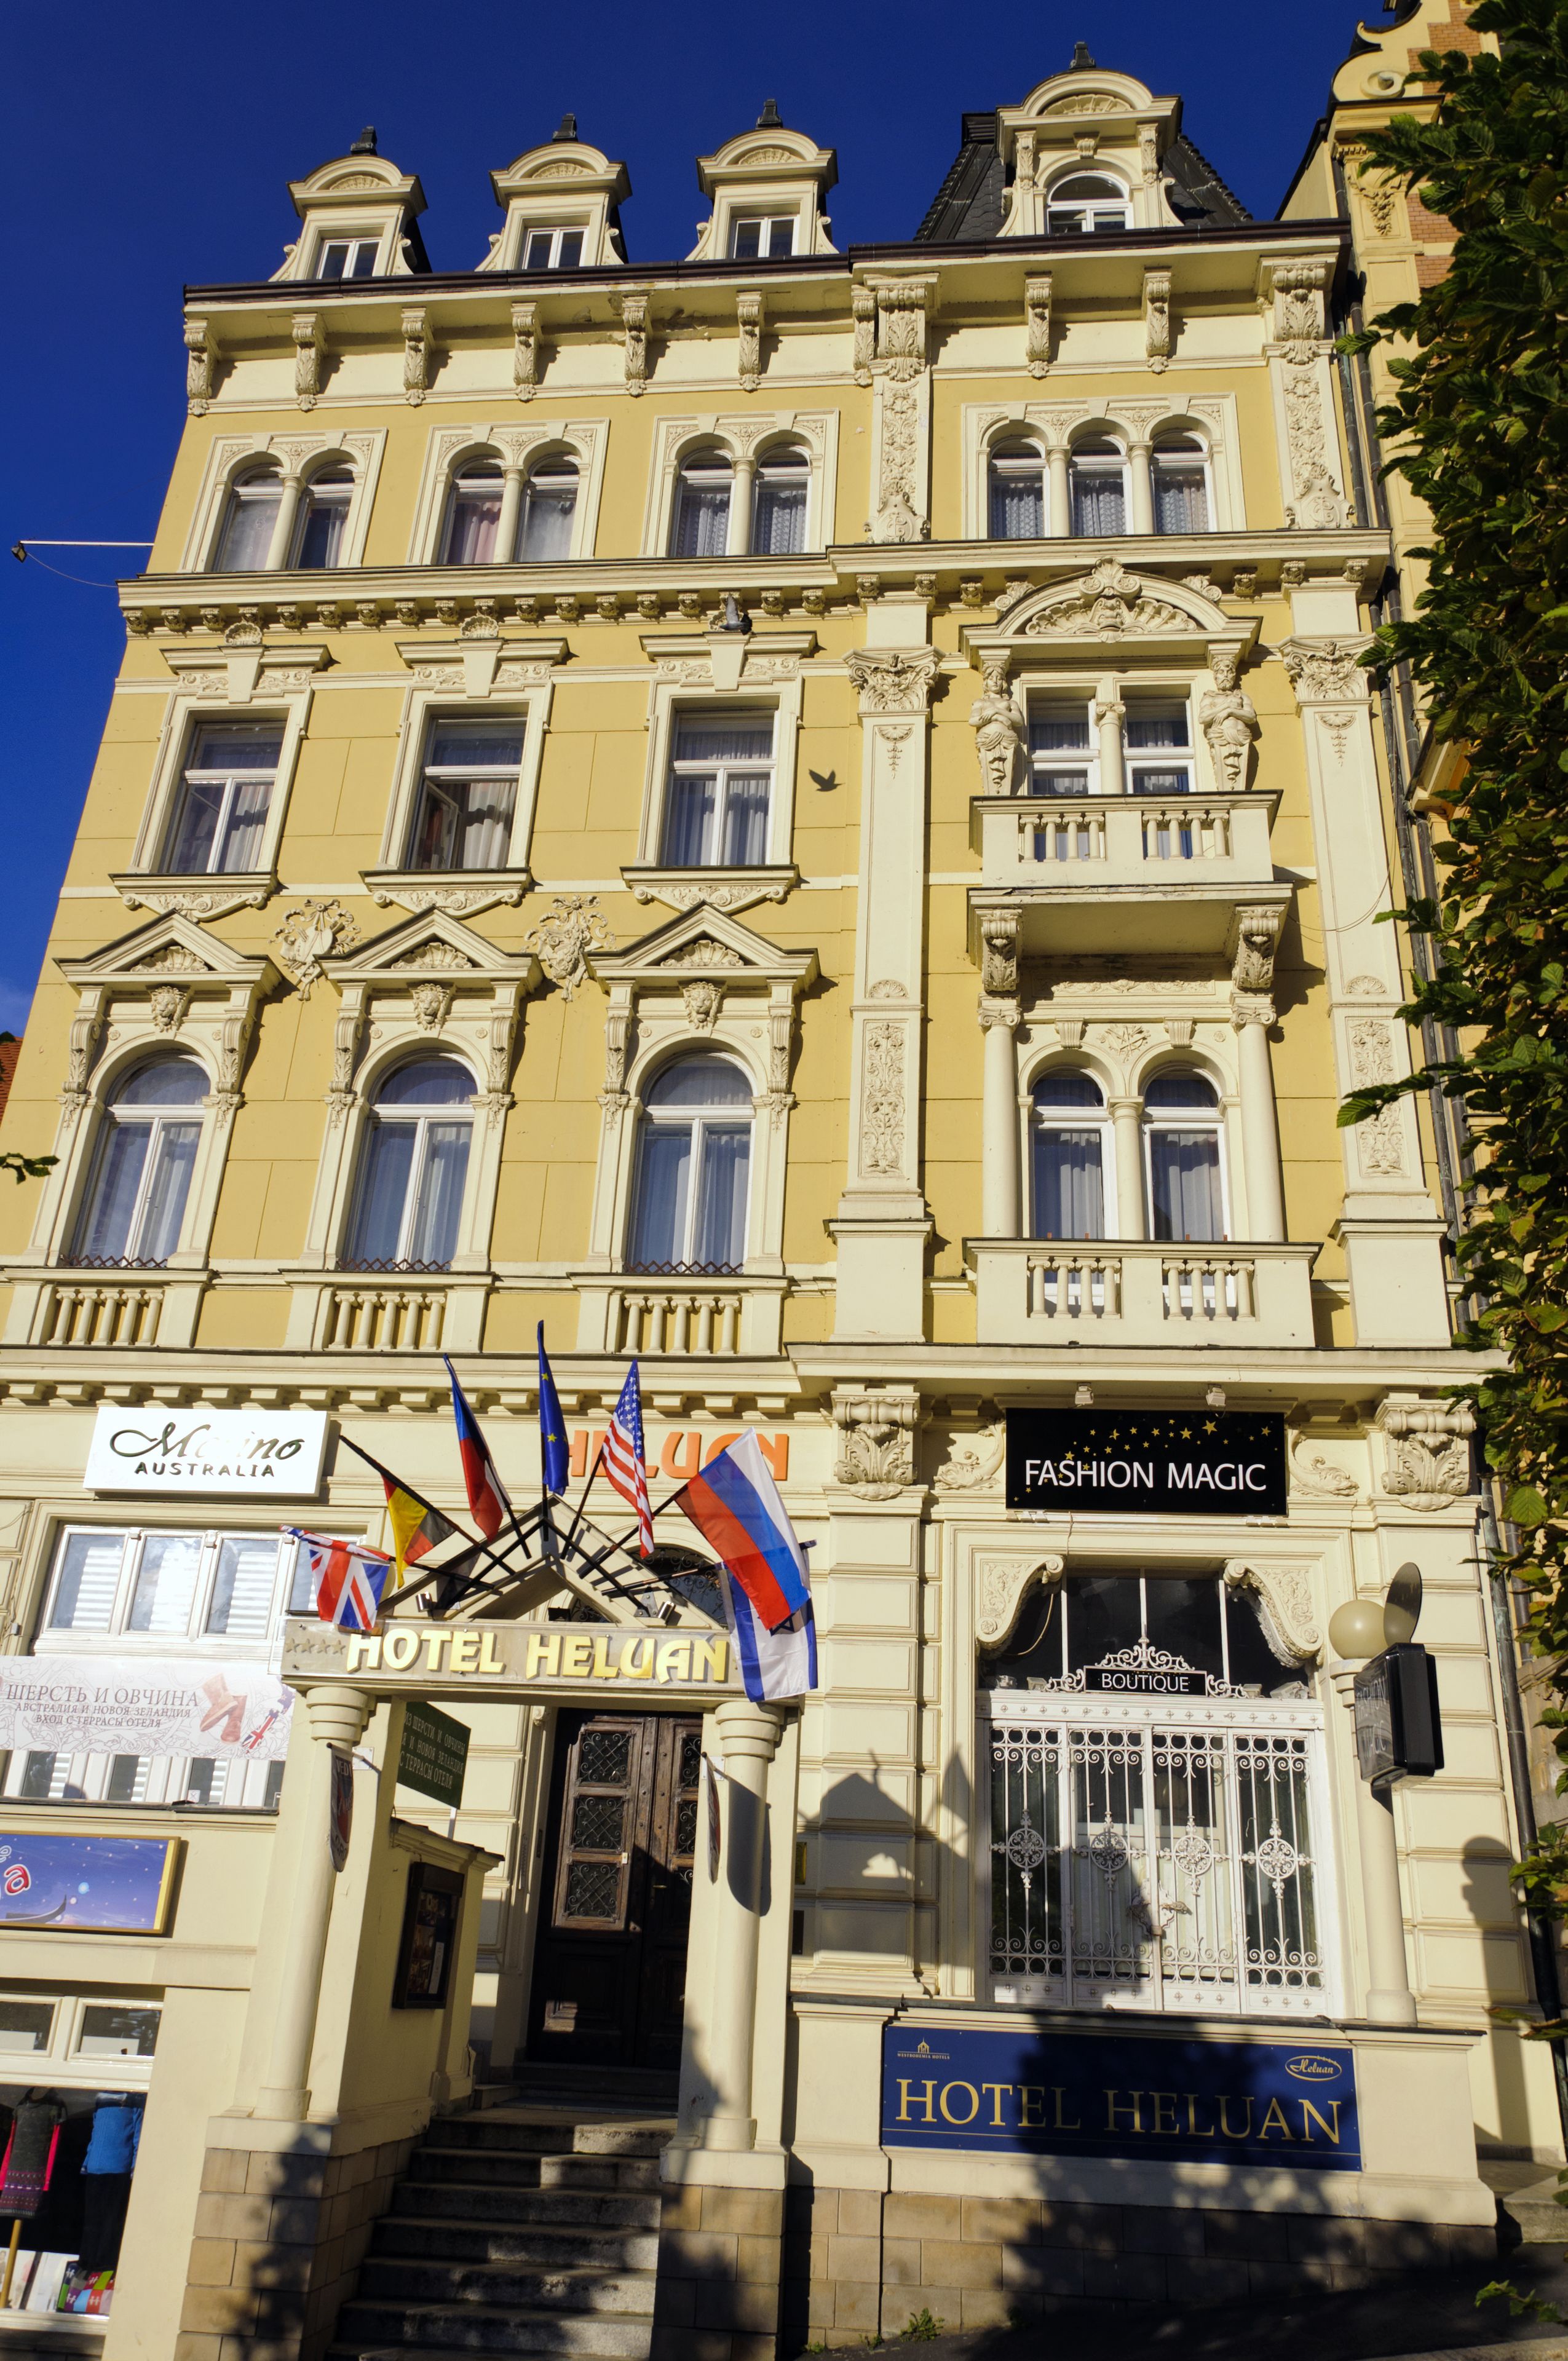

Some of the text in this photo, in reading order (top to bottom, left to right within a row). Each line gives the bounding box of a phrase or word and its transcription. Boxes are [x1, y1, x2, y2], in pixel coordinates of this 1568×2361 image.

[109, 1422, 305, 1460] Mino
[134, 1461, 274, 1477] AUSTRALIA
[1025, 1459, 1267, 1490] FASHION MAGIC
[346, 1628, 730, 1685] HOTEL HELUAN
[6, 1683, 199, 1707] ШЕРСТЬ И ОВЧИНА
[1101, 1673, 1190, 1693] BOUTIQUE
[15, 1703, 78, 1714] АВСТРАЛИЯ
[81, 1705, 89, 1714] И
[134, 1707, 191, 1718] ЗЕЛАНДИЯ
[36, 1714, 162, 1728] ВХОД С ТЕРРАСЫ ОТЕЛЯ
[413, 1715, 435, 1739] ШЕРСТИ
[437, 1730, 443, 1743] И
[405, 1753, 434, 1780] ТЕРРАСЫ
[434, 1767, 453, 1789] ОТЕЛЯ
[1289, 2058, 1334, 2074] Heluan
[895, 2079, 1342, 2144] HOTEL HELUAN
